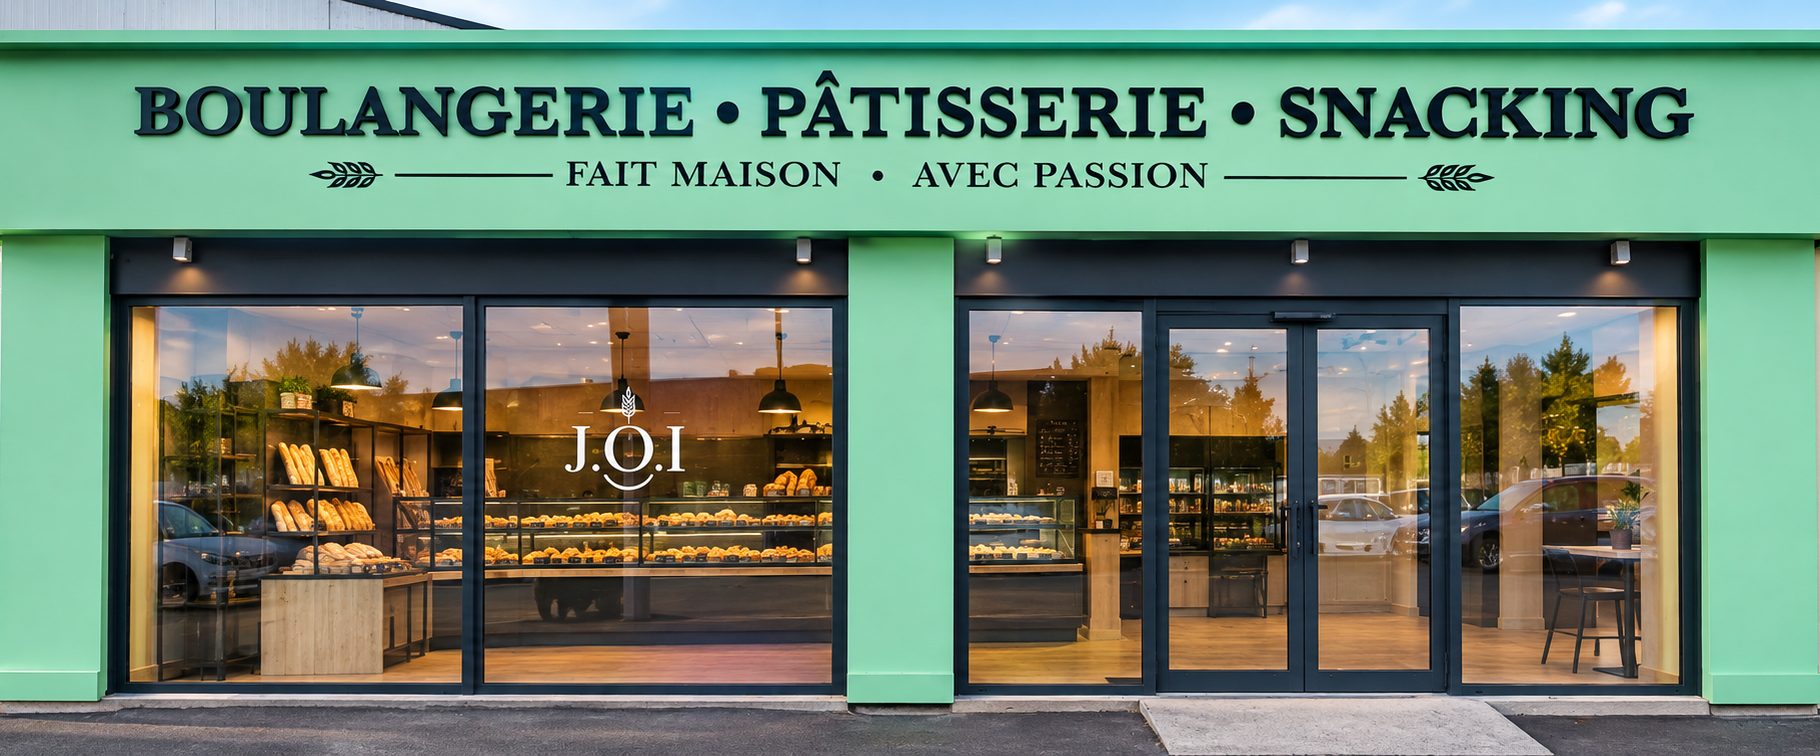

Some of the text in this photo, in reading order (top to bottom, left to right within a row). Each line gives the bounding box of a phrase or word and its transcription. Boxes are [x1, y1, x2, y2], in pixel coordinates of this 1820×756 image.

[133, 69, 1695, 140] BOULANGERIE PÂTISSERIE SNACKING
[566, 160, 1209, 189] FAIT MAISON AVEC PASSION
[564, 425, 686, 473] J.O.I
